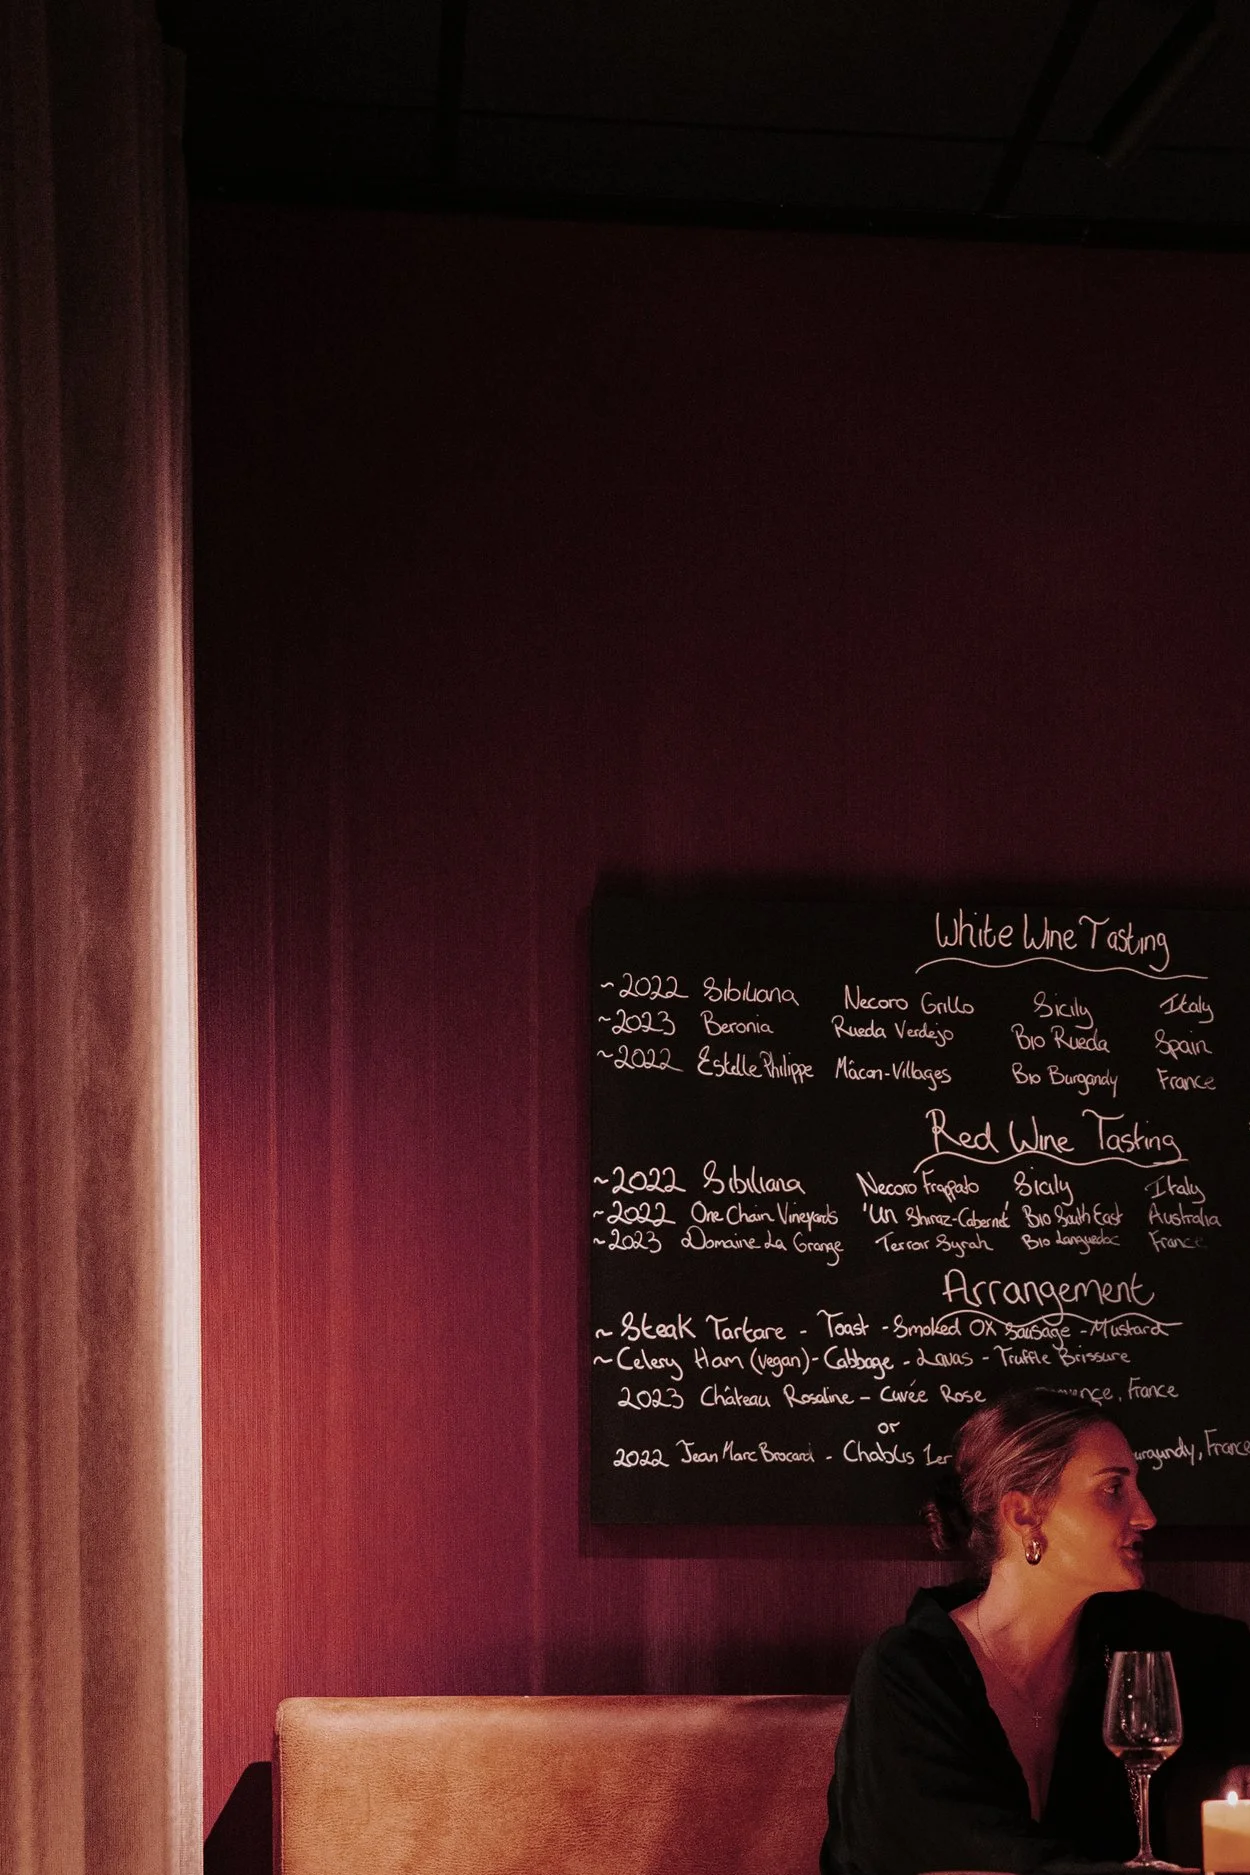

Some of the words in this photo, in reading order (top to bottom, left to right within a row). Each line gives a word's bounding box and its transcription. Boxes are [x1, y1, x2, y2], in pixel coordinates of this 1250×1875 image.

[936, 908, 1013, 948] White
[1024, 913, 1077, 950] Wine
[1079, 915, 1169, 972] Tasting
[704, 977, 799, 1006] Sibiliana
[921, 992, 974, 1014] Grillo
[1034, 991, 1094, 1030] Sicily
[1160, 993, 1214, 1023] Italy
[700, 1010, 774, 1036] Beronia
[831, 1015, 886, 1038] Rueda
[895, 1014, 954, 1047] Verdejo
[1011, 1023, 1045, 1050] Bio
[1051, 1022, 1110, 1053] Rueda
[1155, 1029, 1212, 1060] Spain
[697, 1045, 761, 1078] Estelle
[761, 1051, 814, 1084] Philippe
[836, 1056, 951, 1091] Mâcon-Villages
[1012, 1063, 1041, 1084] Bio
[1157, 1068, 1216, 1091] France
[925, 1109, 998, 1153] Red
[1009, 1116, 1074, 1154] Wine
[1082, 1109, 1183, 1163] Tasting
[703, 1160, 805, 1194] Sibiliana
[1014, 1164, 1076, 1206] Sicily
[1145, 1175, 1205, 1205] Italy
[691, 1201, 724, 1223] One
[726, 1203, 775, 1225] Chain
[1022, 1205, 1051, 1228] Bio
[1054, 1203, 1090, 1227] South
[1093, 1203, 1123, 1226] East
[1149, 1203, 1221, 1226] Australia
[681, 1224, 761, 1250] Domaine
[764, 1230, 787, 1251] La
[793, 1231, 844, 1266] Grange
[936, 1233, 994, 1258] Syrah
[1021, 1234, 1050, 1250] Bio
[944, 1269, 1155, 1326] Arrangement
[706, 1315, 786, 1343] Tartare
[817, 1310, 869, 1338] Toast
[893, 1312, 962, 1338] Smoked
[1089, 1318, 1170, 1338] Mustard
[694, 1347, 744, 1369] Ham
[824, 1346, 894, 1380] Cabbage
[993, 1344, 1054, 1366] Truffle
[618, 1387, 684, 1410] 2023
[700, 1384, 771, 1407] Château
[878, 1379, 928, 1403] Cuvée
[940, 1384, 986, 1403] Rose
[1128, 1377, 1178, 1399] France
[878, 1422, 900, 1434] or
[613, 1448, 669, 1467] 2022
[676, 1440, 718, 1463] Jean
[723, 1440, 758, 1462] Marc
[843, 1440, 914, 1464] Chablis
[1134, 1436, 1202, 1472] urgundy,
